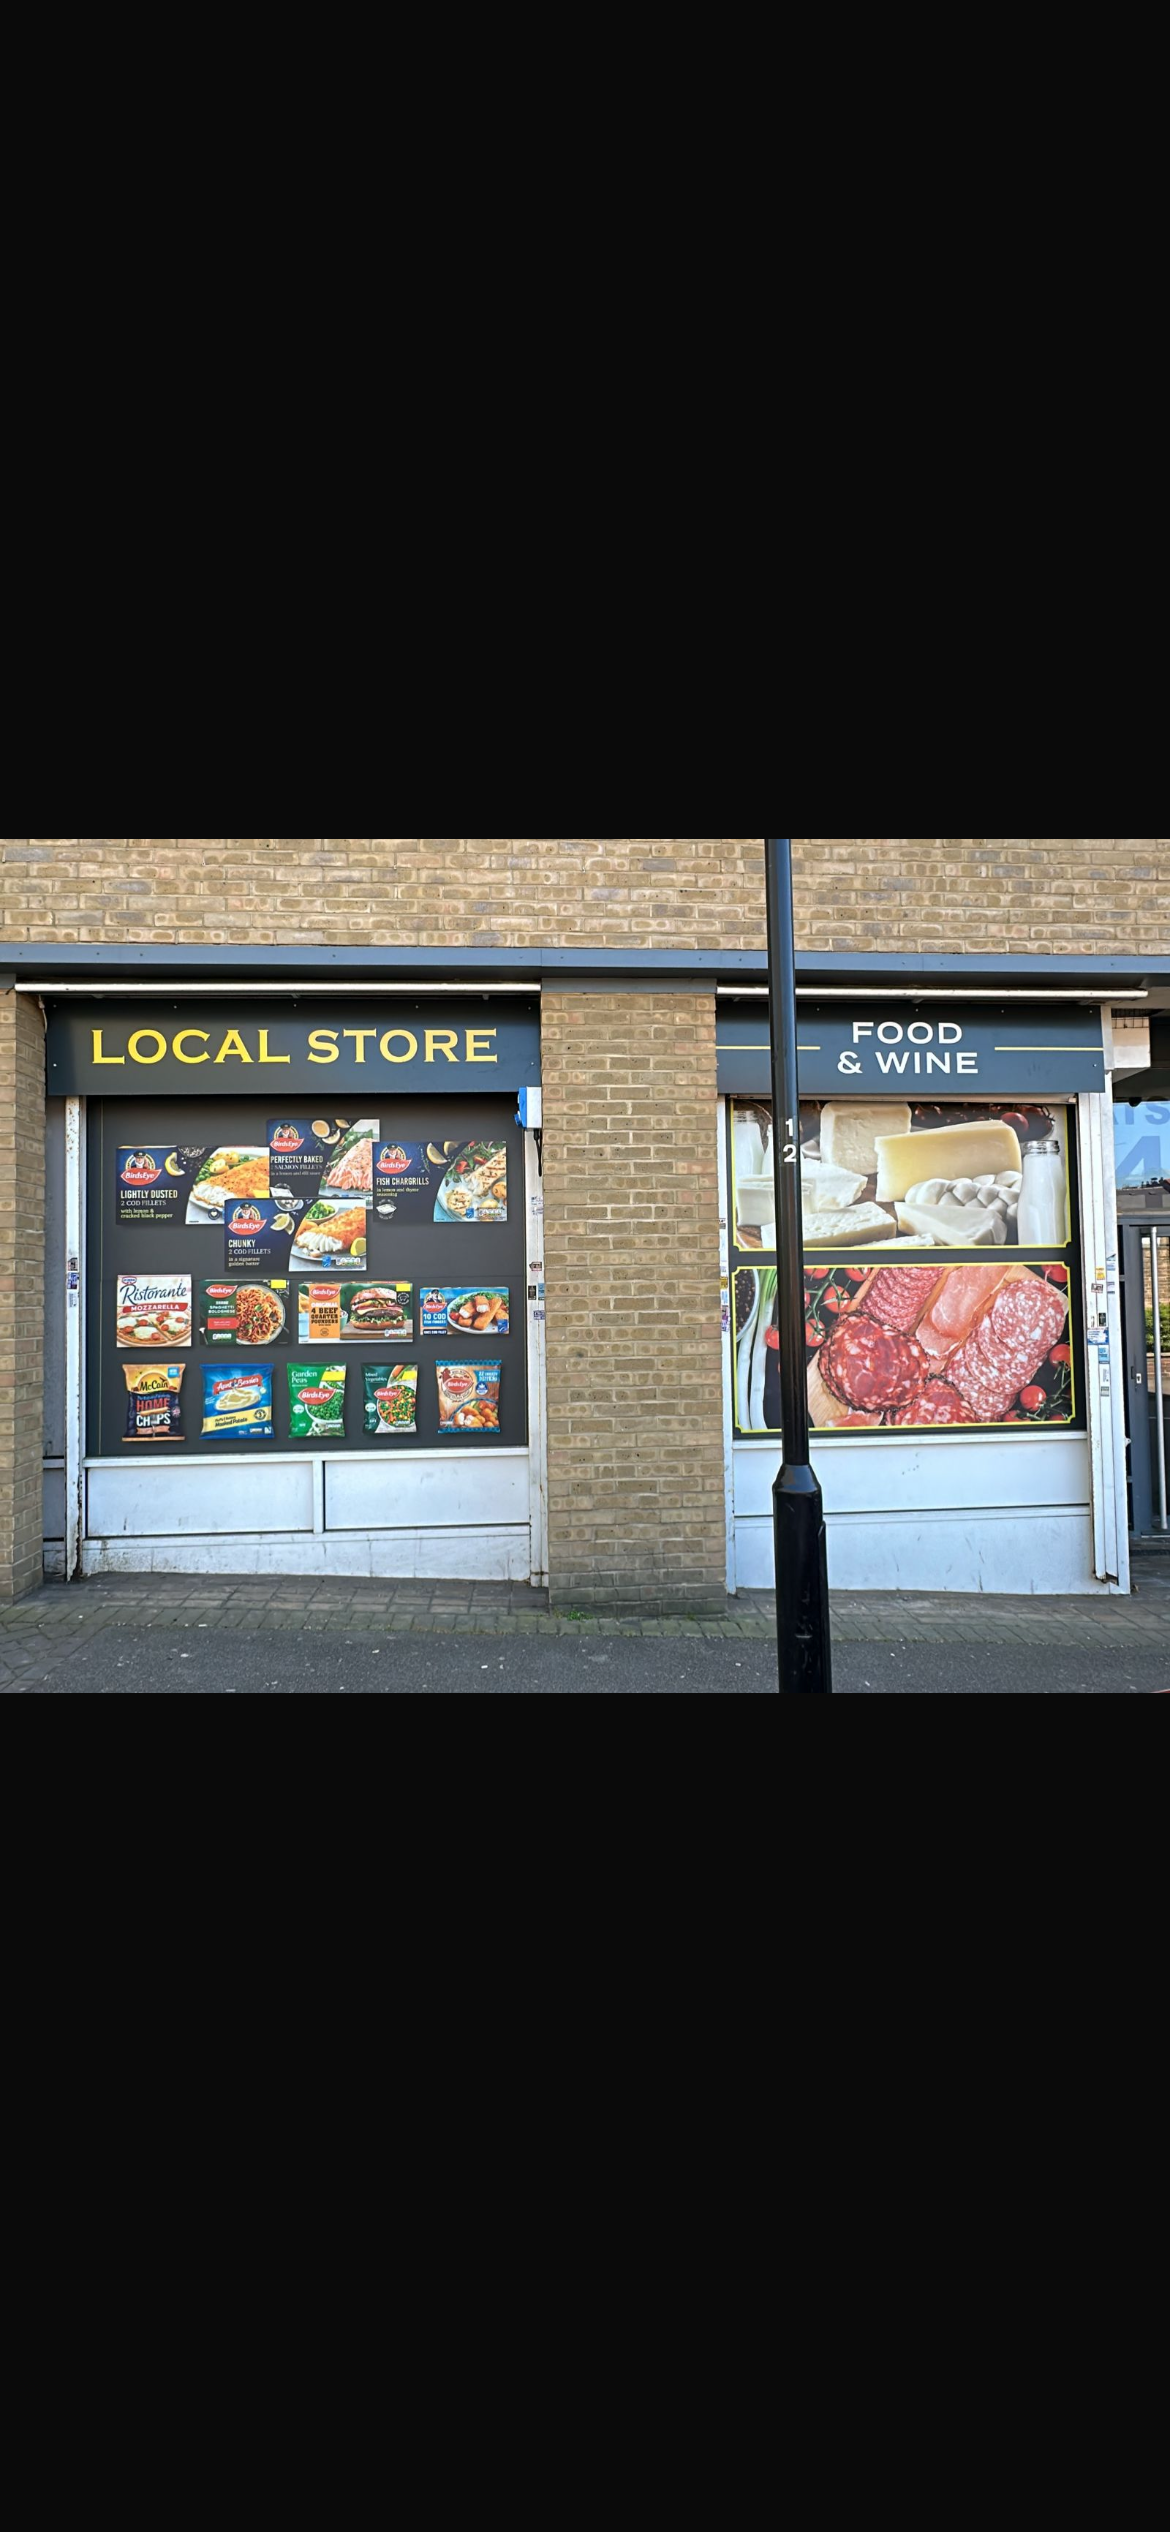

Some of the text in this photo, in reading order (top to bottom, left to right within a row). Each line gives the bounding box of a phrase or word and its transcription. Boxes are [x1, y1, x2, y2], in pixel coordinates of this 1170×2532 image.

[852, 1021, 964, 1045] FOOD
[91, 1028, 499, 1064] LOCAL STORE
[837, 1050, 980, 1075] & WINE
[270, 1155, 324, 1163] PERFECTLY BAKED
[376, 1177, 430, 1185] FISH CHARGRILLS
[120, 1189, 178, 1199] LIGHTLY DUSTED
[228, 1239, 256, 1248] CHUNKY
[120, 1282, 187, 1305] Ristorante
[130, 1304, 180, 1312] MOZZARELLA
[140, 1378, 169, 1391] McCain
[136, 1397, 171, 1412] HOME
